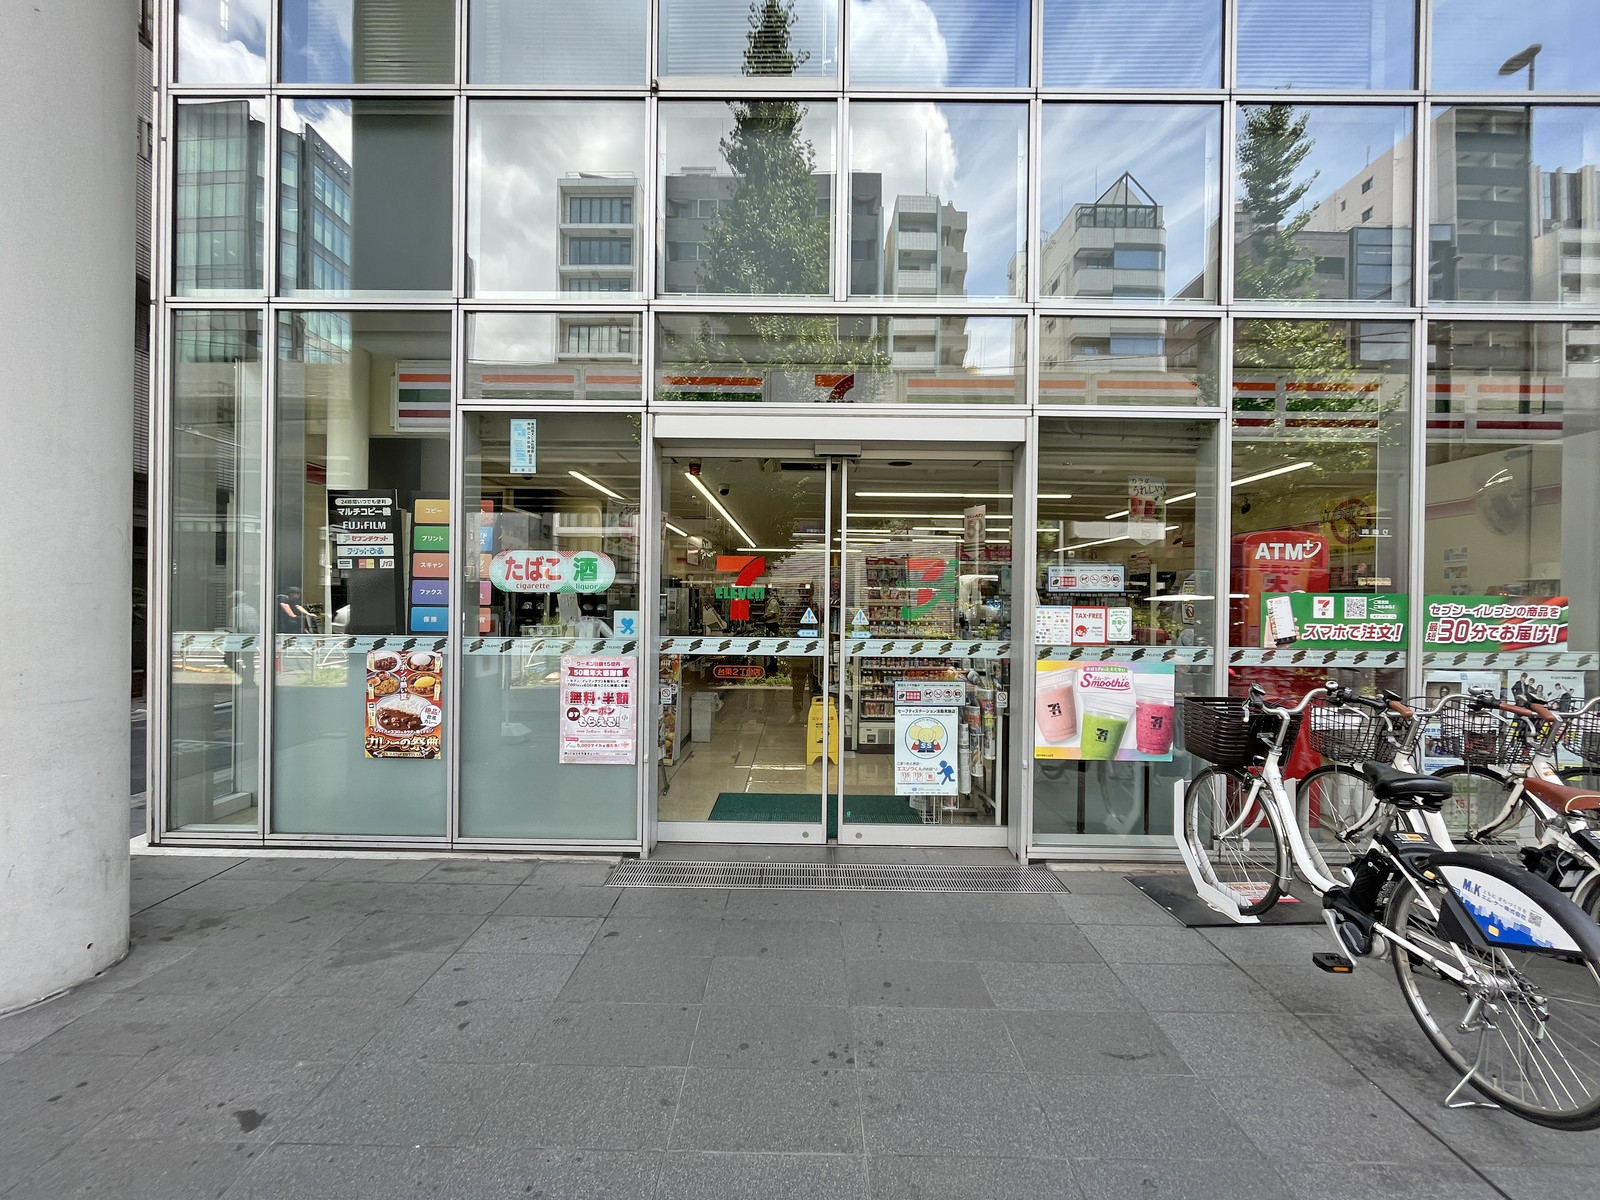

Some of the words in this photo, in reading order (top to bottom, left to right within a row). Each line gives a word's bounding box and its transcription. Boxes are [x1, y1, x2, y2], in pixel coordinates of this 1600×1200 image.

[337, 507, 391, 516] マルチコピー機
[343, 521, 386, 530] FUJIFILM
[347, 547, 384, 555] チケットぴあ
[505, 556, 561, 581] たばこ
[573, 557, 598, 581] 酒
[1304, 625, 1401, 640] スマホで注文!
[1080, 673, 1130, 688] Smoothie
[570, 691, 629, 704] 無料・半額
[582, 707, 615, 715] クーポン
[578, 716, 620, 728] もらえる!
[366, 735, 440, 752] カレーの祭典
